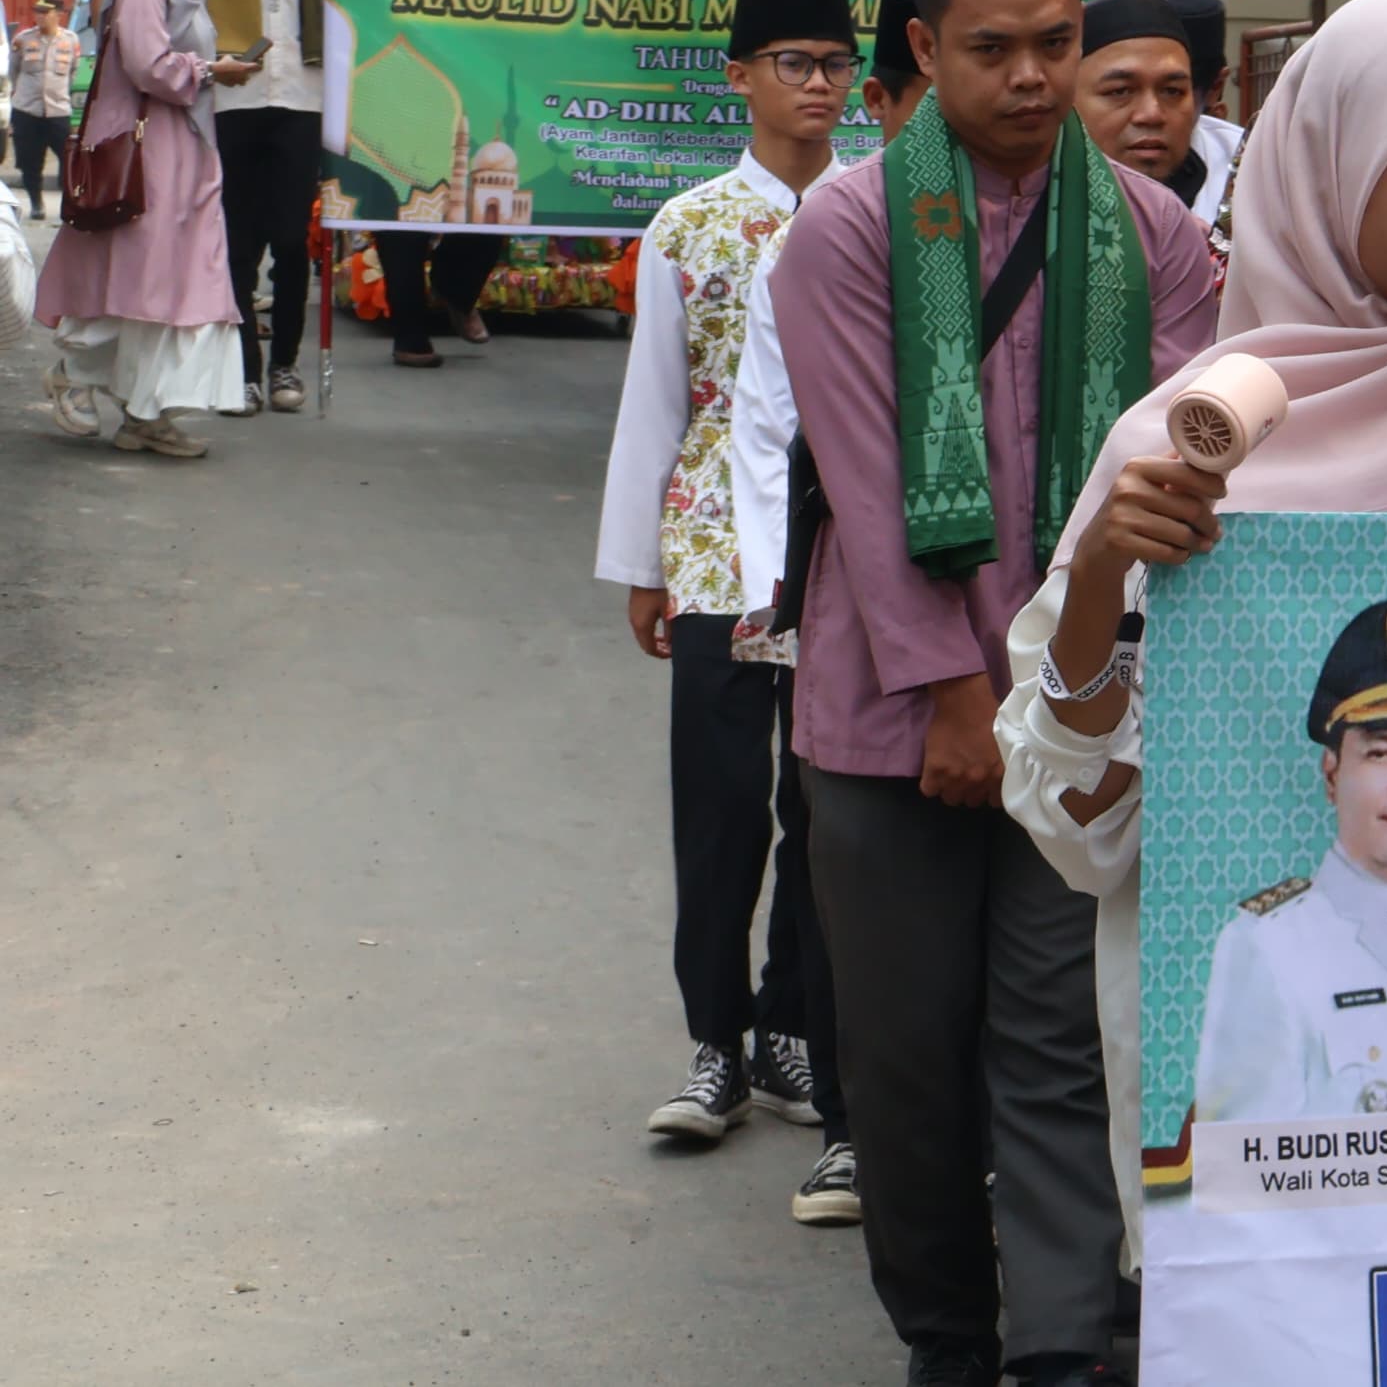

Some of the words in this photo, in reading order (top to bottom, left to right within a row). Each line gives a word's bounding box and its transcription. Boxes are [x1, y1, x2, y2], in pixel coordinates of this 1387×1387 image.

[682, 80, 739, 95] Denga
[563, 99, 694, 124] AD-DIIK
[540, 124, 594, 142] (Ayam
[598, 127, 658, 145] Jantan
[663, 131, 755, 148] Keberkaha
[575, 146, 648, 164] Kearifan
[652, 150, 698, 165] Lokal
[1243, 1137, 1269, 1162] H.
[1277, 1132, 1338, 1161] BUDI
[1261, 1170, 1313, 1193] Wali
[1322, 1169, 1370, 1190] Kota
